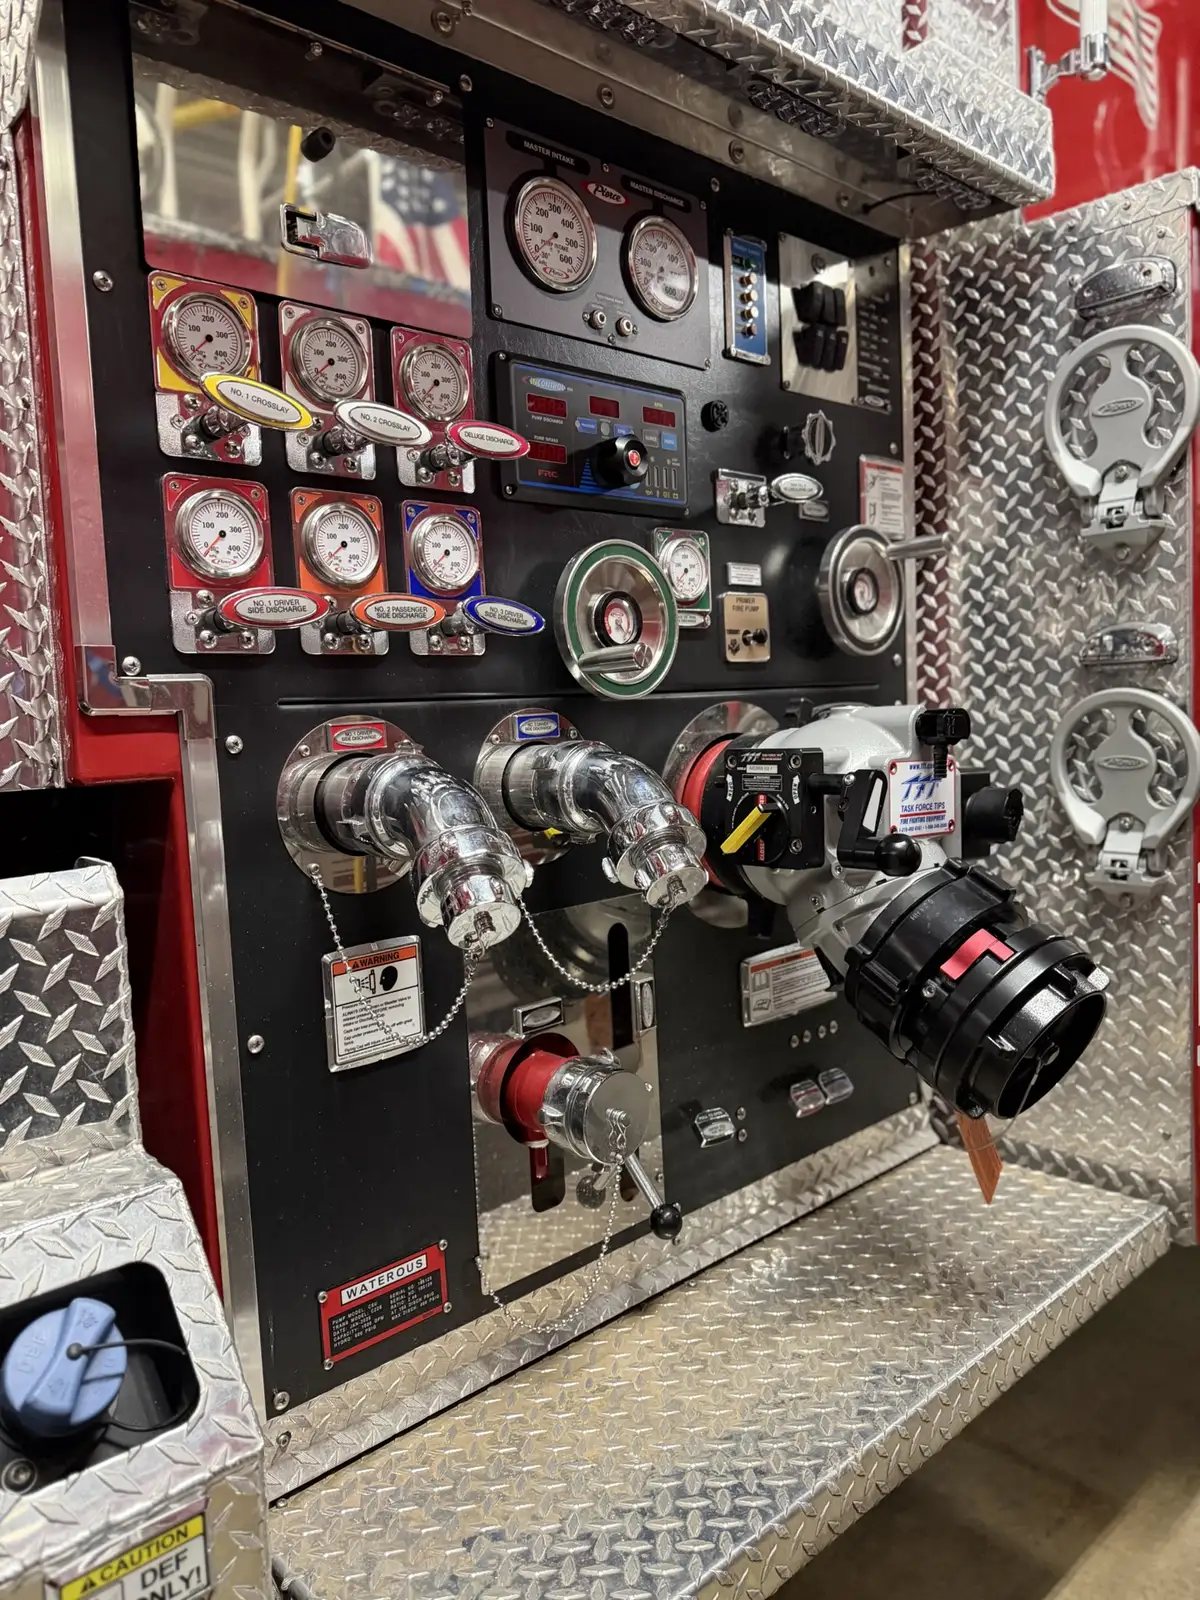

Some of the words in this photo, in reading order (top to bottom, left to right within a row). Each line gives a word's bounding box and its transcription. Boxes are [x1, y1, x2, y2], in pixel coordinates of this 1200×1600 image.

[523, 140, 550, 157] MASTER
[551, 150, 575, 166] INTAKE
[594, 185, 621, 202] Pierce
[629, 181, 653, 196] MASTER
[535, 207, 549, 218] 200
[548, 203, 562, 214] 300
[529, 222, 543, 234] 100
[561, 218, 574, 230] 400
[565, 237, 578, 249] 500
[559, 254, 573, 265] 600
[202, 315, 215, 323] 200
[188, 324, 201, 333] 100
[215, 331, 229, 339] 300
[325, 340, 337, 348] 200
[214, 350, 228, 358] 400
[313, 348, 324, 356] 100
[337, 355, 348, 363] 300
[431, 362, 441, 370] 200
[230, 387, 243, 398] NO.
[251, 395, 290, 414] CROSSLAY
[360, 413, 371, 422] NO.
[379, 417, 411, 432] CROSSLAY
[464, 431, 485, 441] DELUGE
[486, 434, 514, 446] DISCHARGE
[538, 469, 558, 478] FRC
[229, 526, 243, 534] 300
[273, 599, 300, 607] DRIVER
[732, 604, 744, 612] FIRE
[265, 605, 307, 613] DISCHARGE
[484, 611, 497, 619] SIDE
[497, 613, 528, 626] DISCHARGE
[504, 610, 524, 619] DRIVER
[915, 803, 933, 811] FORCE
[926, 814, 946, 822] EQUIPMENT
[360, 951, 399, 967] WARNING
[346, 1258, 424, 1300] WATEROUS
[332, 1316, 346, 1325] PUMP
[333, 1321, 349, 1331] TRANS
[333, 1327, 347, 1337] DATE:
[333, 1328, 360, 1342] CAPACITY:
[100, 1525, 189, 1581] CAUTION
[140, 1548, 189, 1590] DEF
[136, 1565, 201, 1600] NLY!
